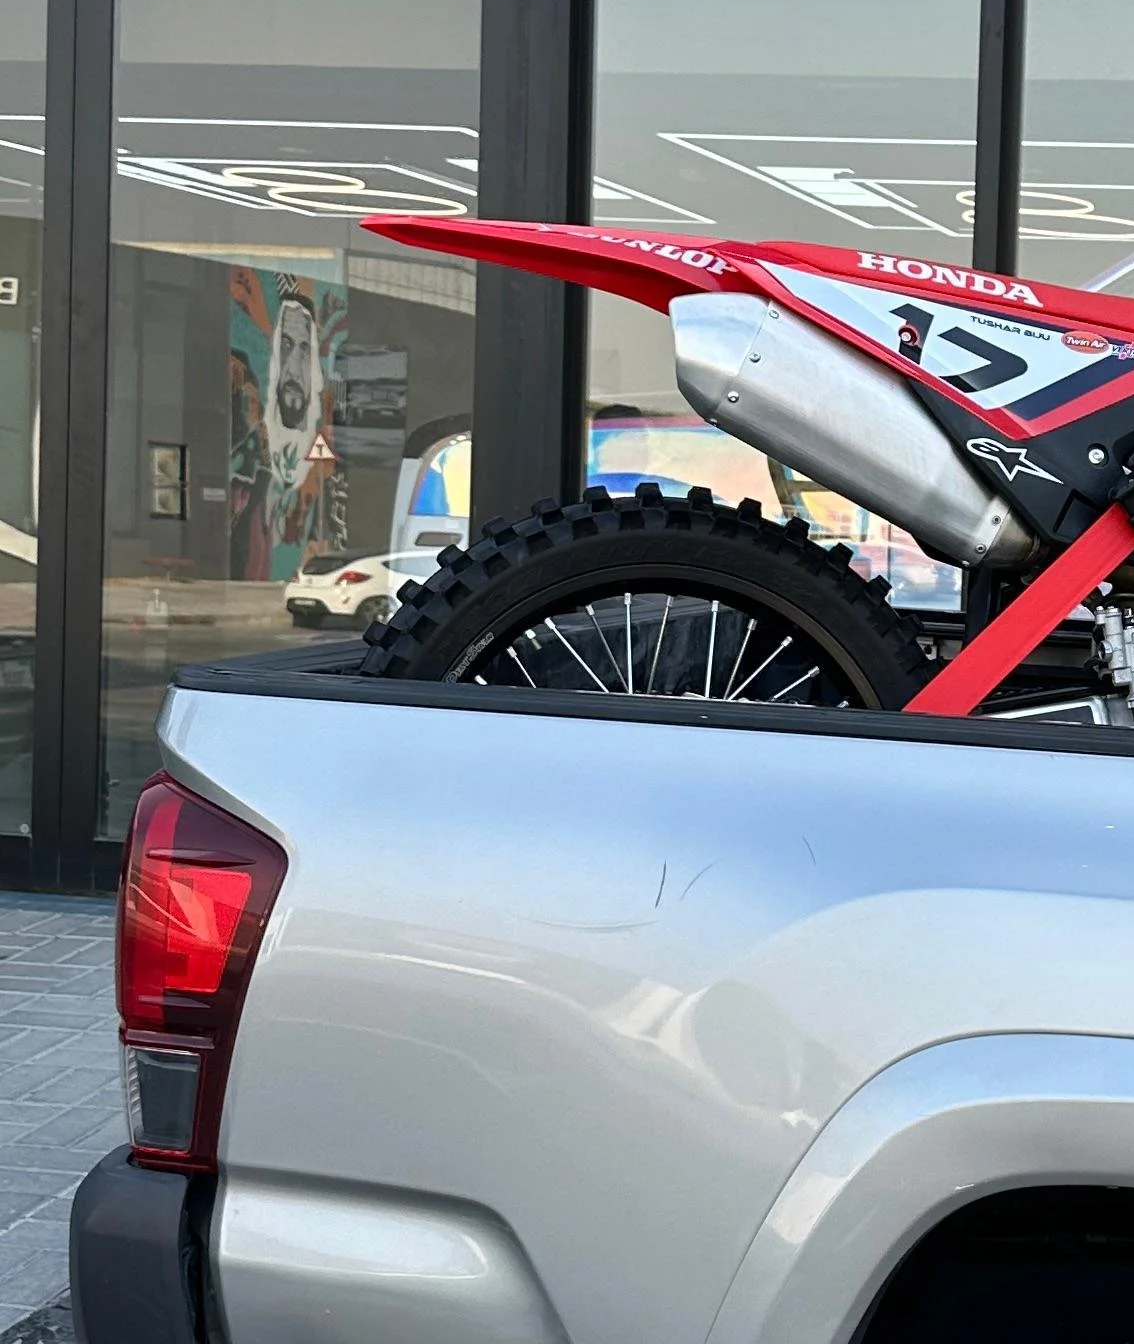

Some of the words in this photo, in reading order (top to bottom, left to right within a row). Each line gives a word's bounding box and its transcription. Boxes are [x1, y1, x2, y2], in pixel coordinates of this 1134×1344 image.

[857, 250, 1044, 308] HONDA
[970, 316, 1021, 335] TUSHAR
[1066, 336, 1090, 347] Twin
[1090, 339, 1106, 348] Air
